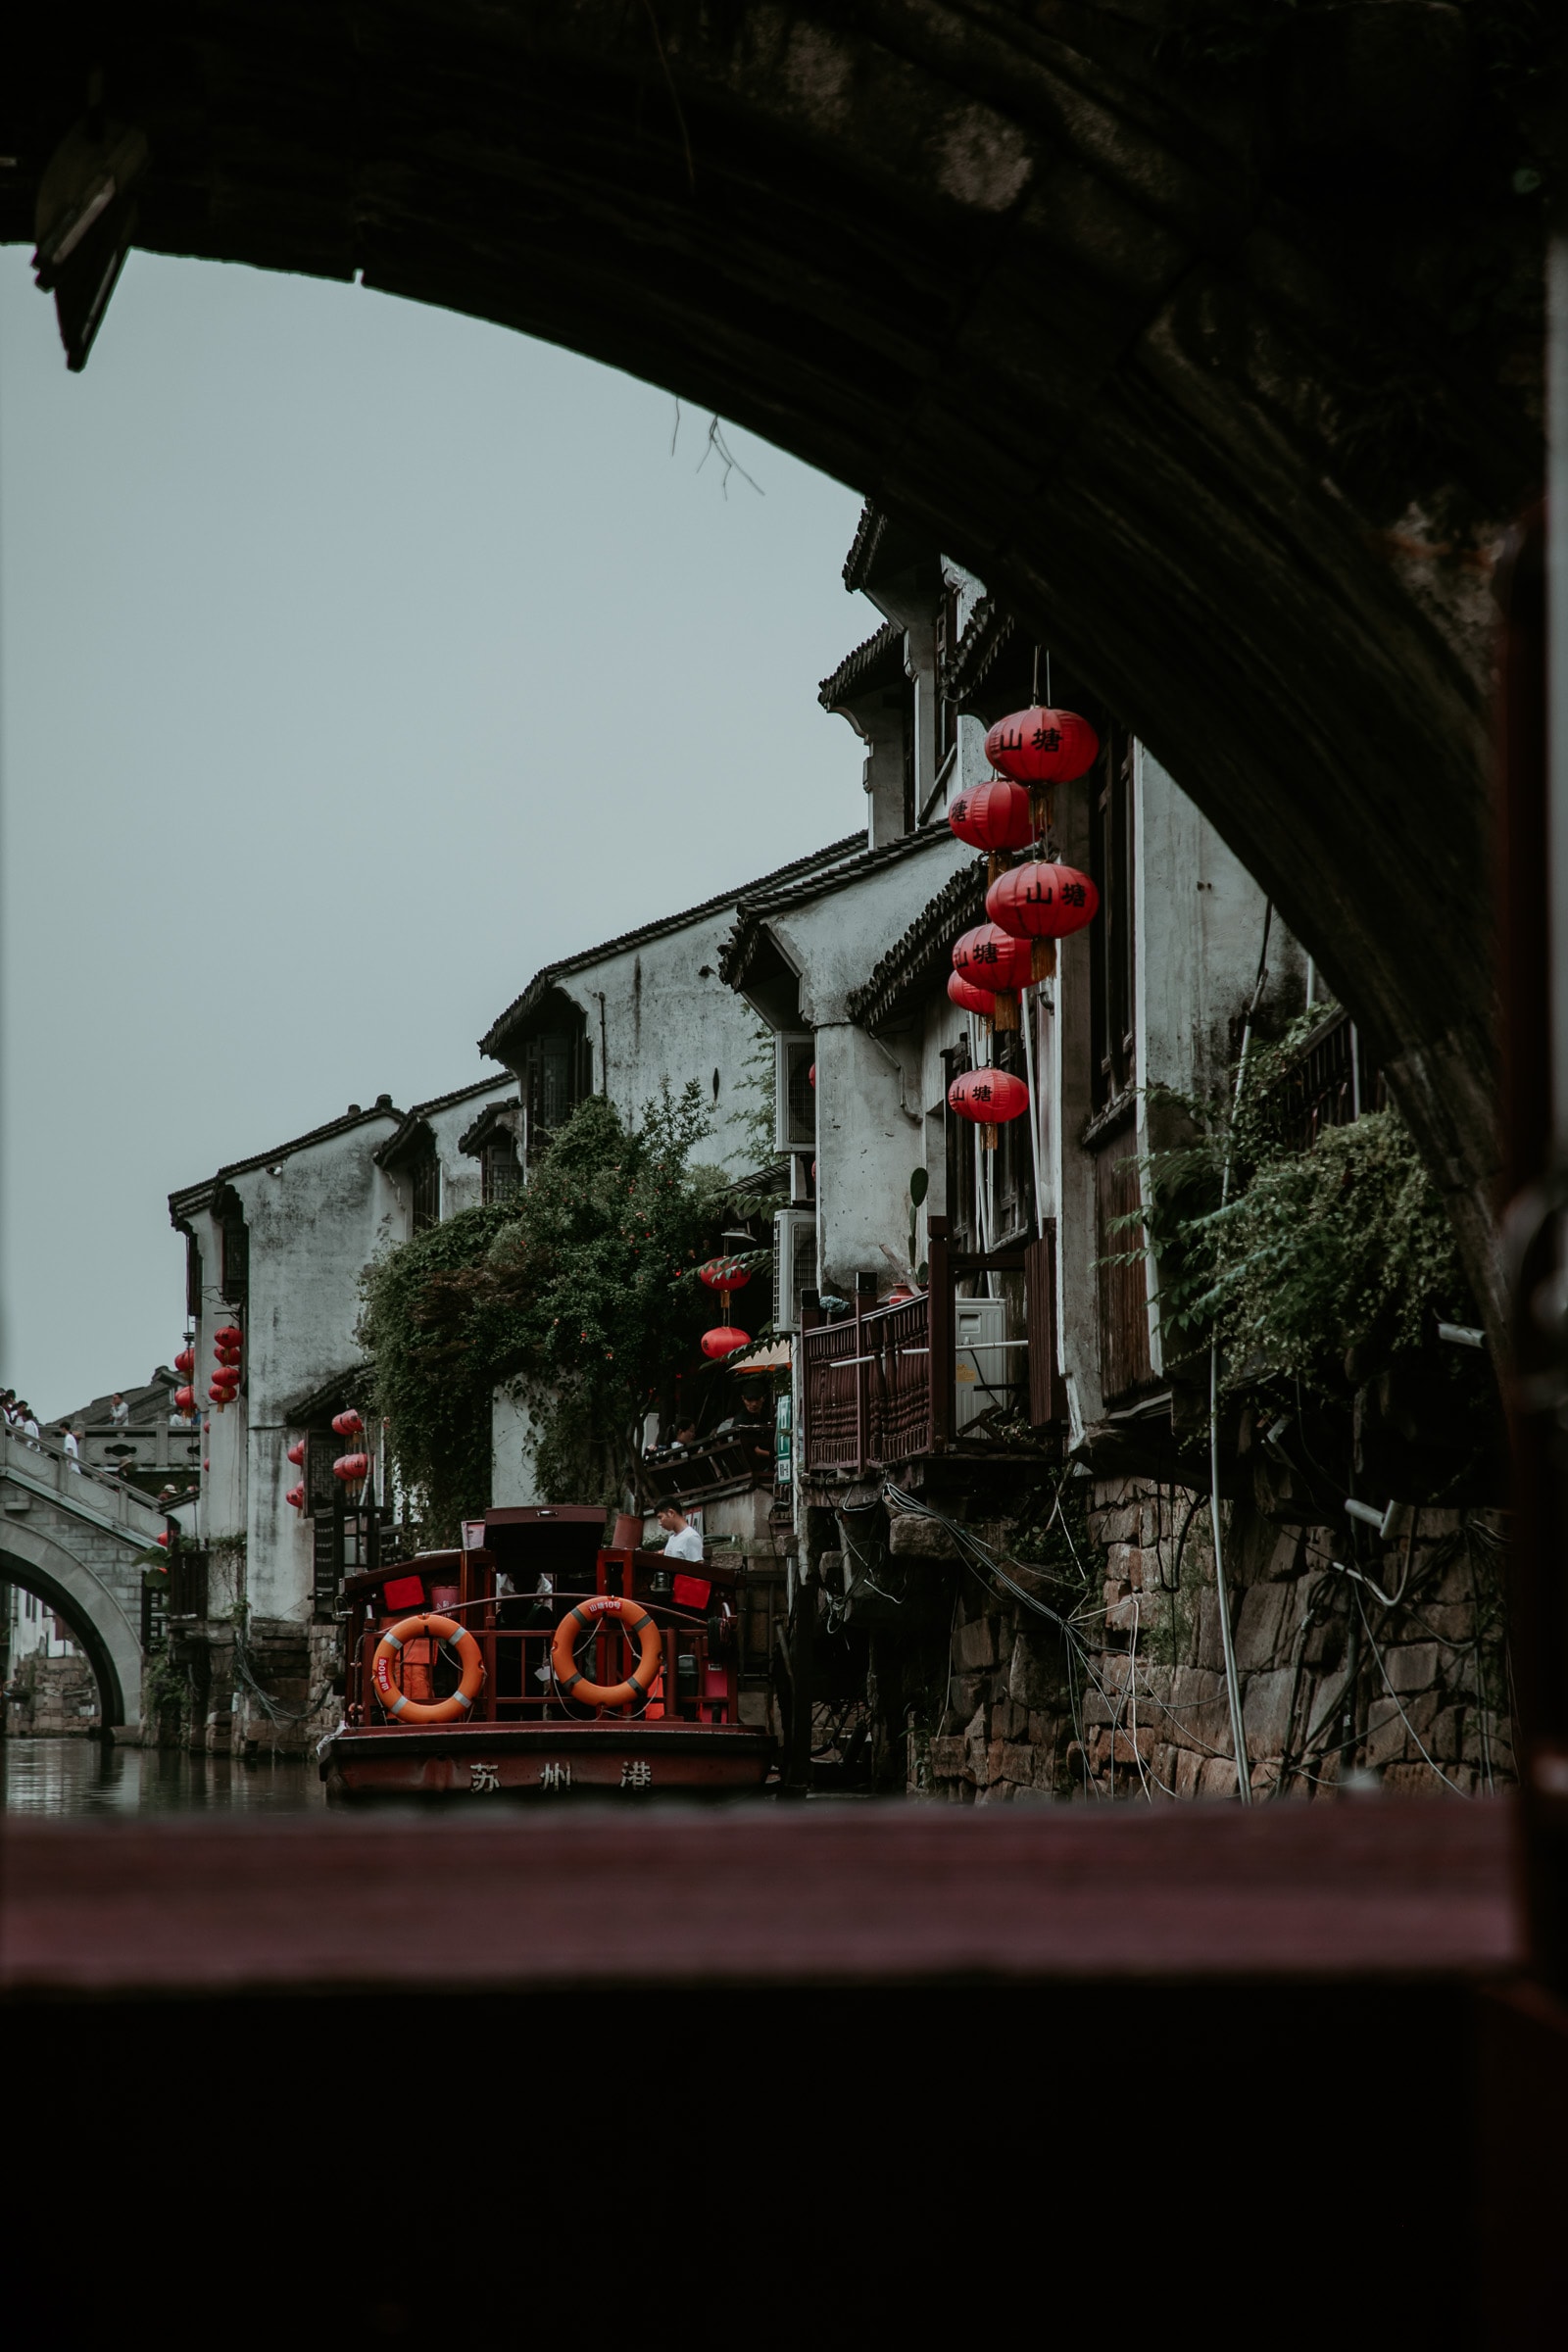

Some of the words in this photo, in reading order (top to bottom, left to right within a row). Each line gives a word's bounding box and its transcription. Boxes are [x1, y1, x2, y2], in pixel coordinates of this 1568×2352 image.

[1001, 727, 1064, 753] 山塘
[1026, 882, 1086, 907] 山塘
[953, 1085, 993, 1102] 山塘
[469, 1761, 652, 1794] 苏州港
